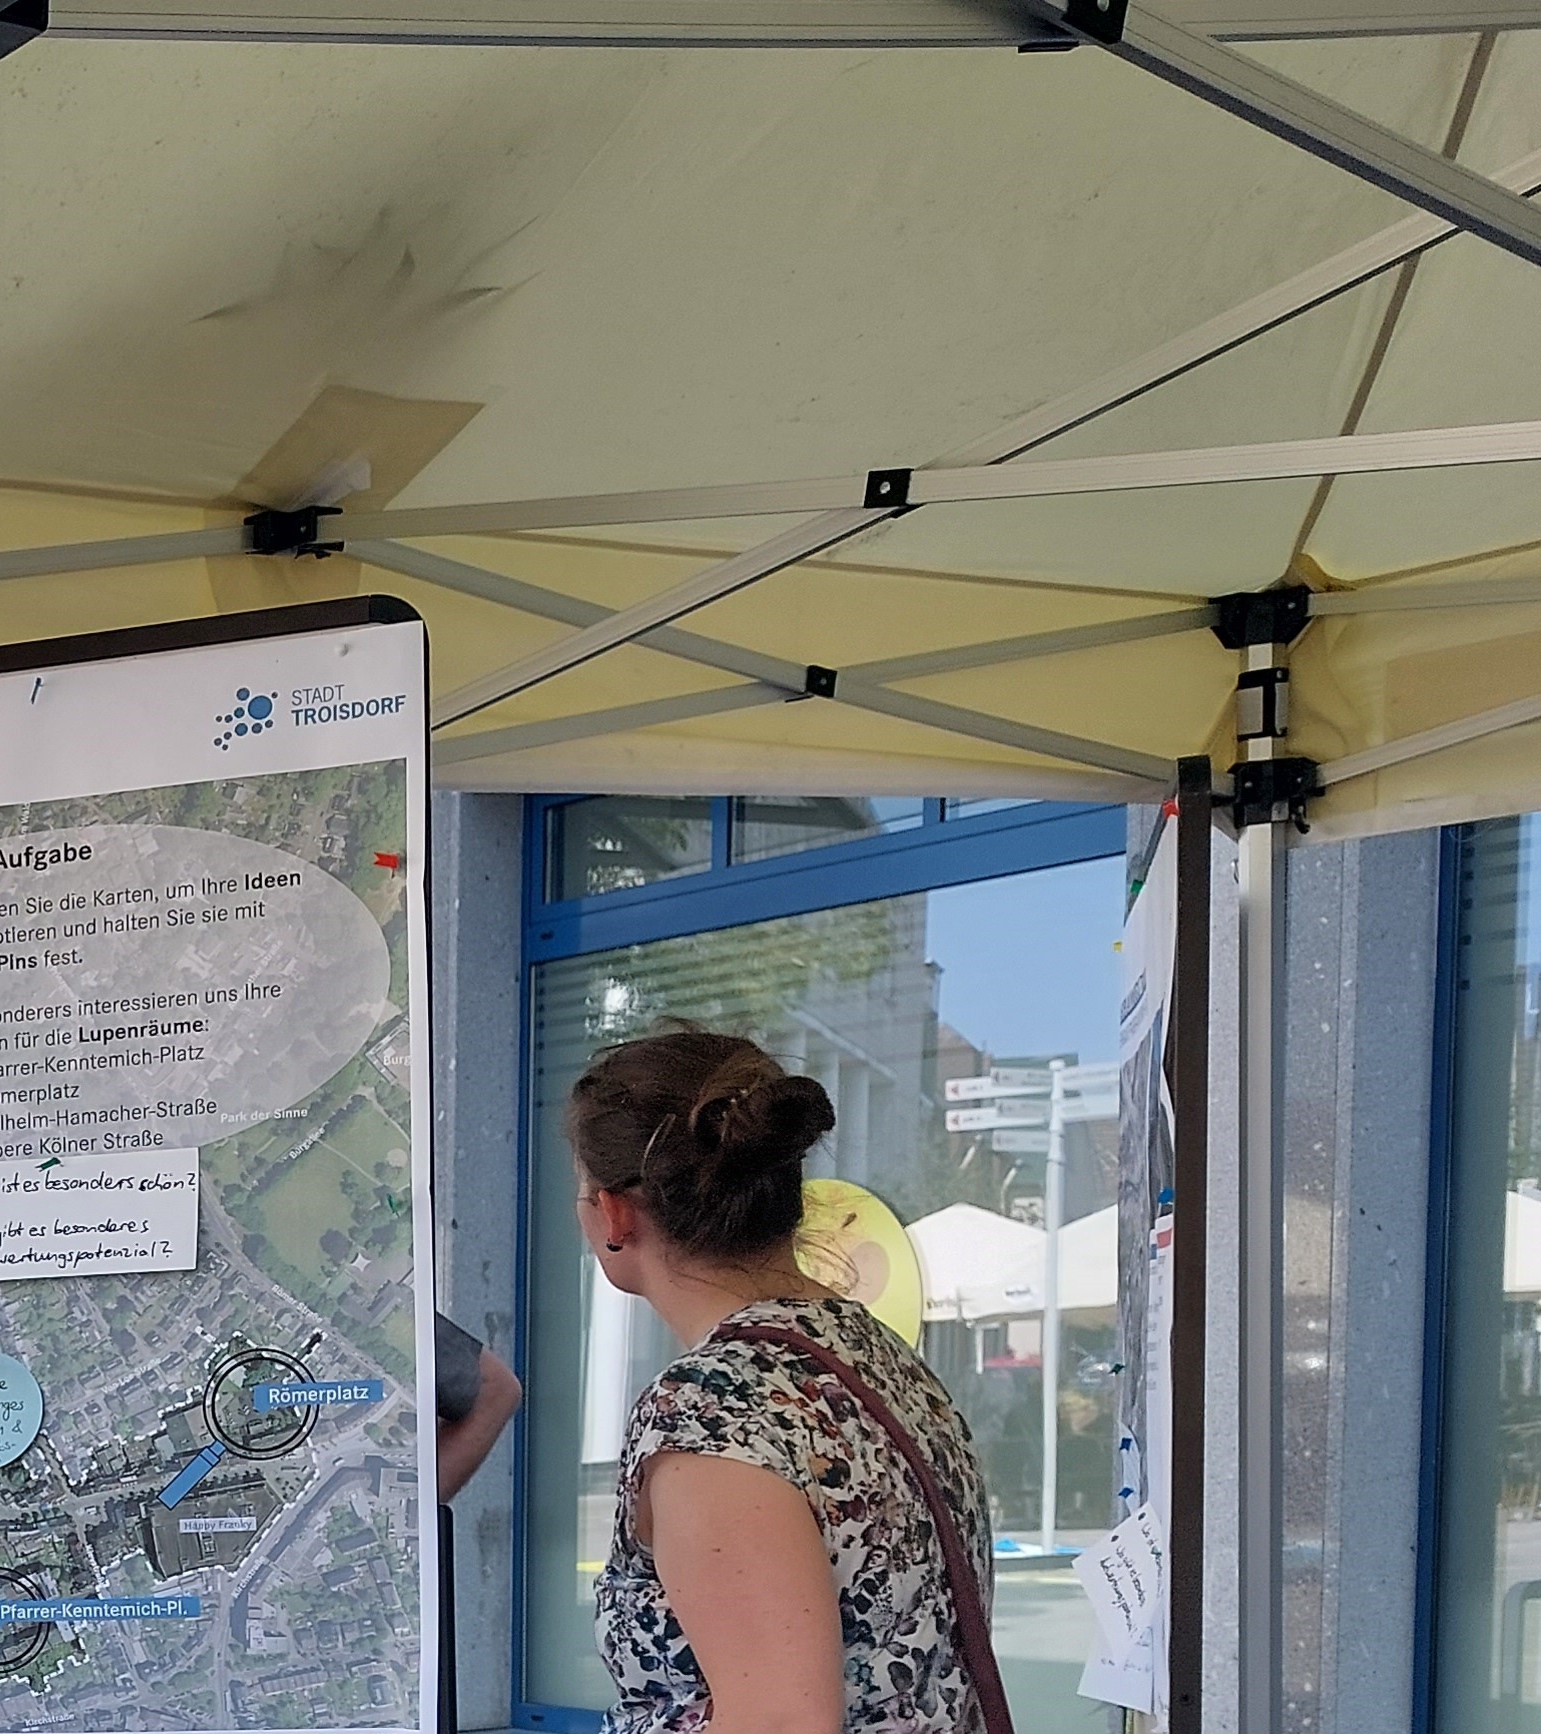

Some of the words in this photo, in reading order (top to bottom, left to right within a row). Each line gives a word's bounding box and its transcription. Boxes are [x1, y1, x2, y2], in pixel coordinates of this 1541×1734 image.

[291, 684, 345, 706] STADT
[291, 695, 406, 726] TROISDORF
[25, 897, 54, 915] Sie
[59, 892, 87, 910] die
[93, 886, 159, 907] Karten,
[166, 882, 195, 899] um
[202, 878, 238, 895] Ihre
[244, 870, 302, 891] Ideen
[63, 918, 97, 937] und
[103, 911, 160, 933] halten
[166, 908, 196, 927] Sie
[202, 906, 228, 923] sie
[235, 901, 266, 920] mit
[44, 948, 84, 968] fest.
[78, 992, 198, 1017] interessieren
[204, 989, 238, 1004] uns
[244, 983, 282, 1000] Ihre
[14, 1032, 39, 1050] für
[44, 1028, 72, 1046] die
[79, 1017, 209, 1045] Lupenräume:
[220, 1112, 246, 1123] Park
[251, 1110, 270, 1121] der
[274, 1109, 308, 1119] Sinne
[39, 1136, 97, 1155] Kölner
[103, 1131, 164, 1150] Straße
[2, 1172, 18, 1193] ist
[23, 1180, 40, 1193] es
[45, 1170, 134, 1191] besonders
[138, 1173, 197, 1193] schön?
[29, 1226, 47, 1237] es
[53, 1218, 150, 1236] besonderes
[268, 1386, 369, 1405] Römerplatz
[0, 1602, 188, 1620] Pfarrer-Kenntemich-Pl.
